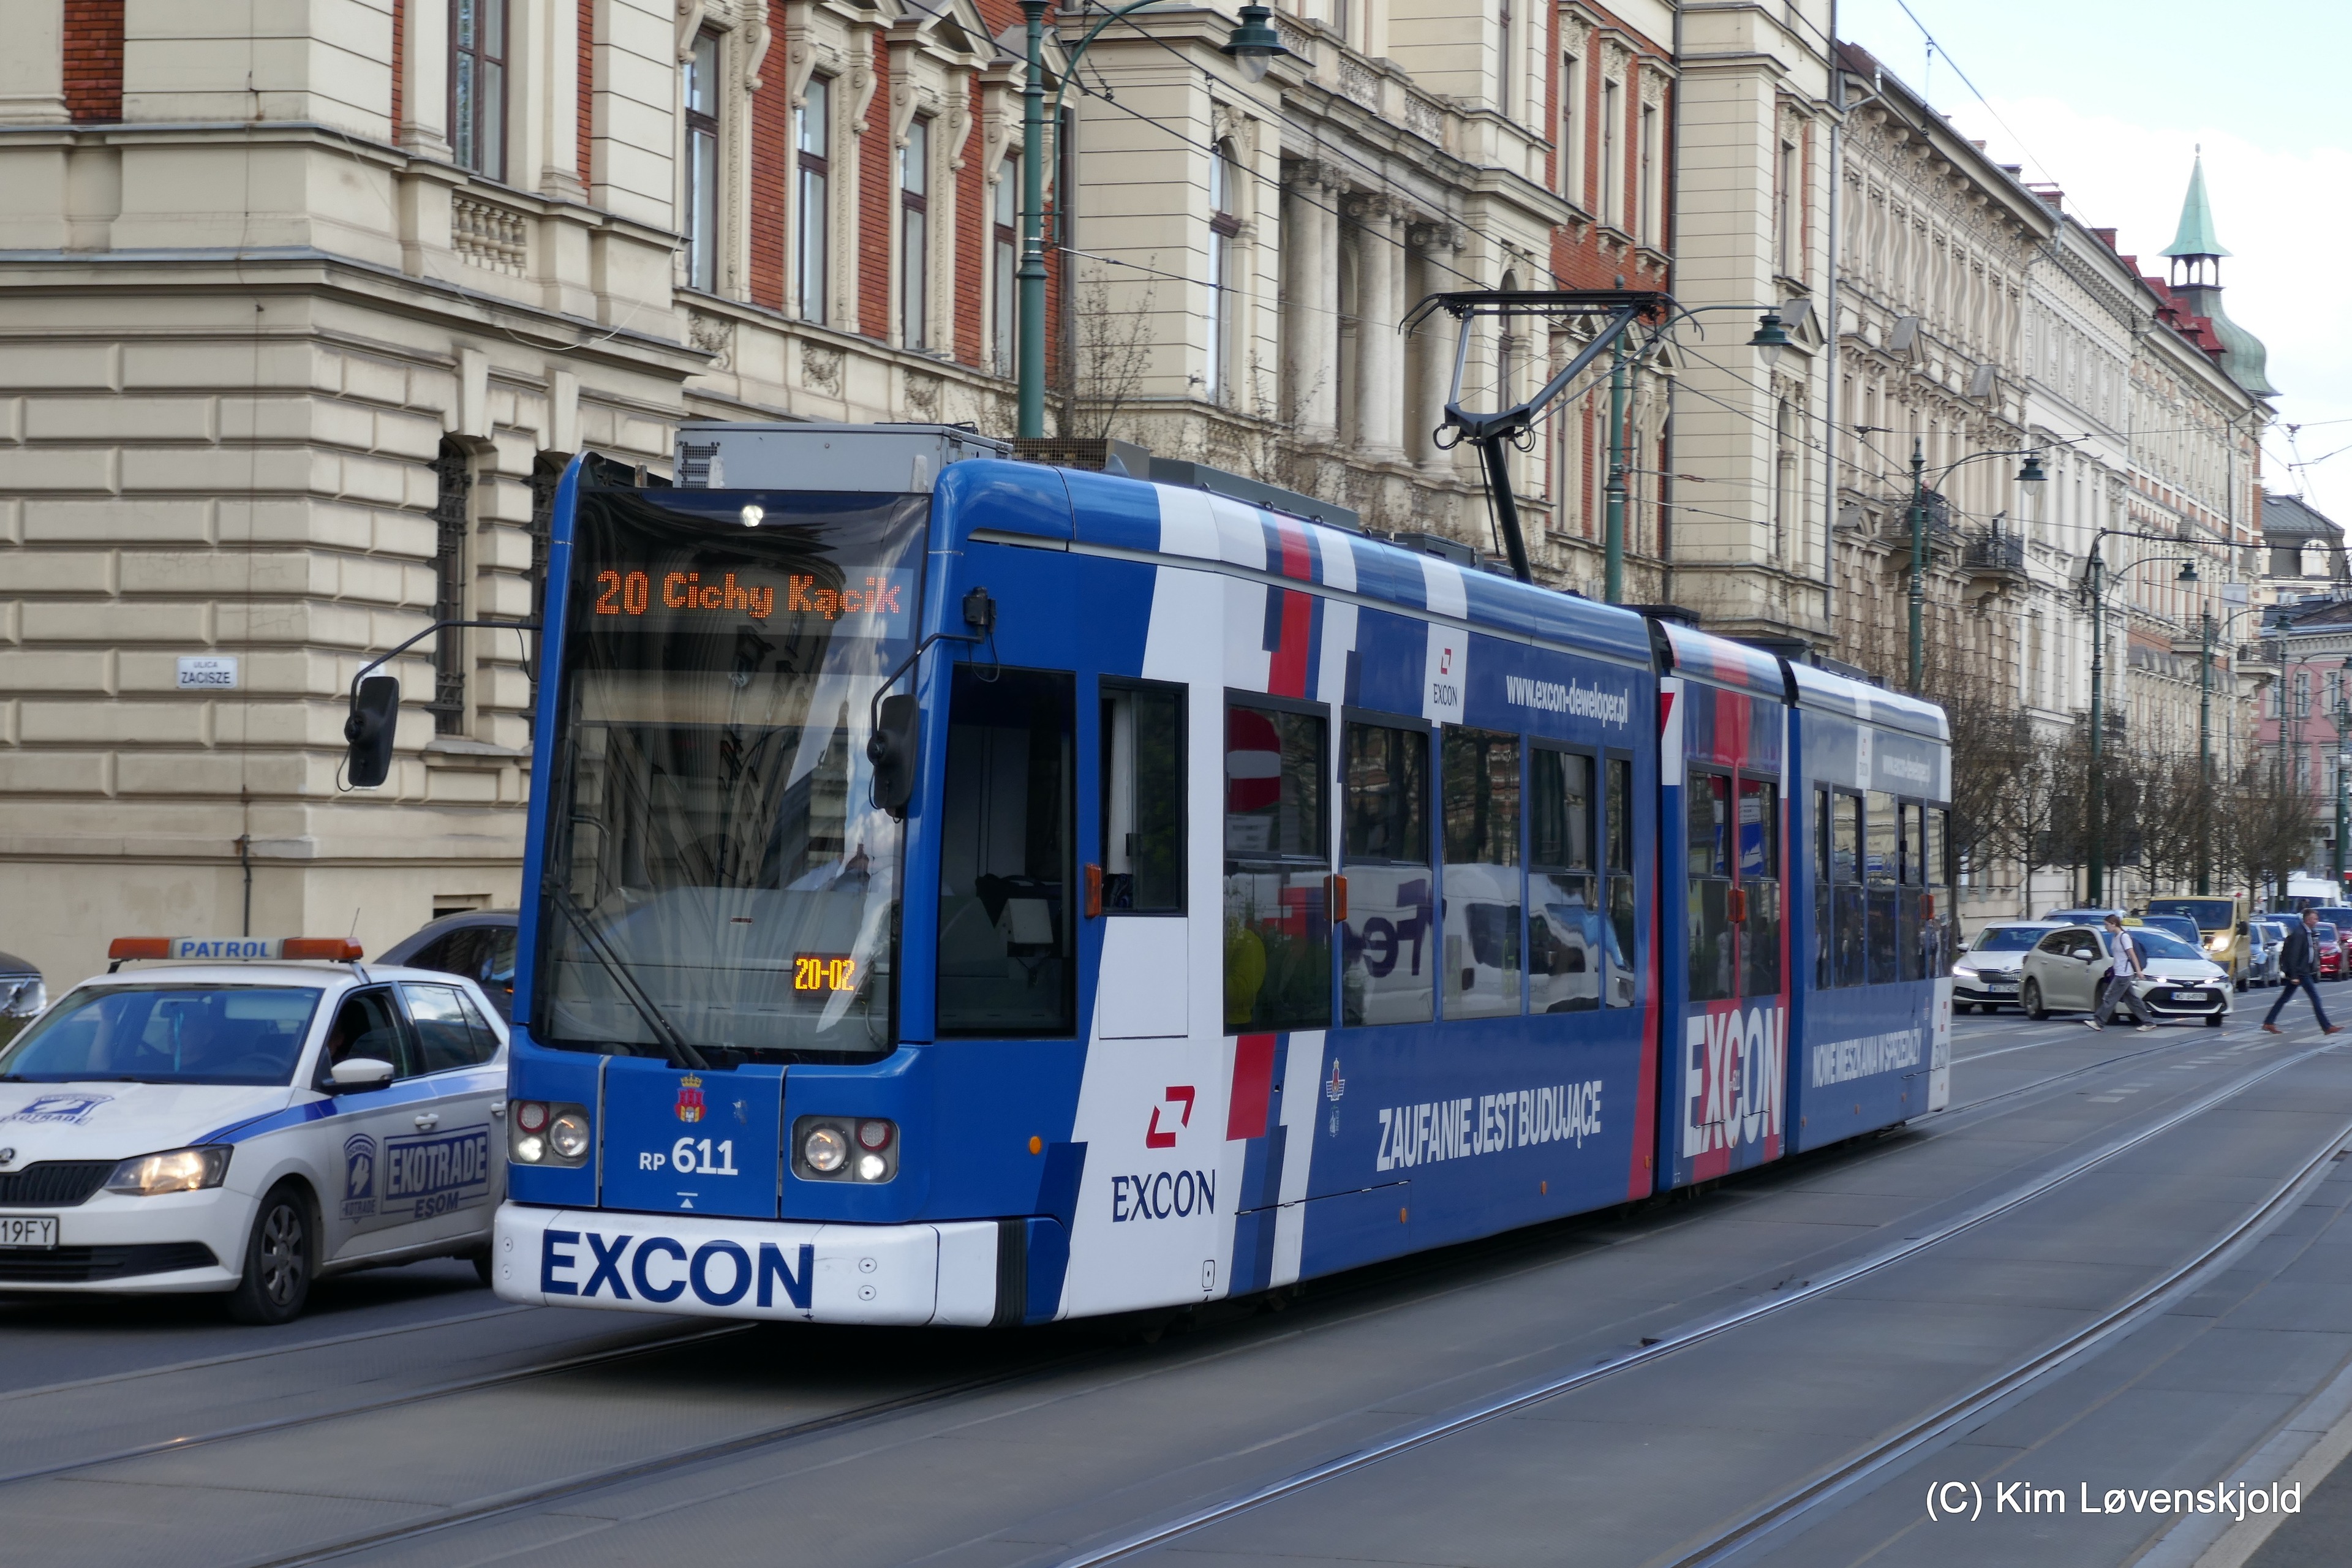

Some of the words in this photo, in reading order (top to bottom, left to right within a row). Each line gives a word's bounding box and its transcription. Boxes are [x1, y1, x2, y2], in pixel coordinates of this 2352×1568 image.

[597, 570, 649, 615] 20
[663, 572, 772, 618] Cichy
[789, 574, 900, 619] Kącik
[182, 672, 230, 684] ZACISZE
[1433, 684, 1457, 706] EXCON
[1507, 676, 1627, 730] www.excon-deweloper.pl
[181, 941, 271, 957] PATROL
[795, 959, 855, 991] 20-02
[1684, 1008, 1784, 1158] EXCON
[1377, 1098, 1471, 1172] ZAUFANIE
[1473, 1092, 1517, 1155] JEST
[1518, 1080, 1602, 1149] BUDUJĄCE
[388, 1136, 486, 1194] EKOTRADE
[640, 1153, 665, 1170] RP
[673, 1137, 738, 1175] 611
[415, 1191, 459, 1218] ESOM
[1112, 1169, 1215, 1222] EXCON
[1, 1221, 51, 1242] 19FY
[540, 1229, 814, 1309] EXCON
